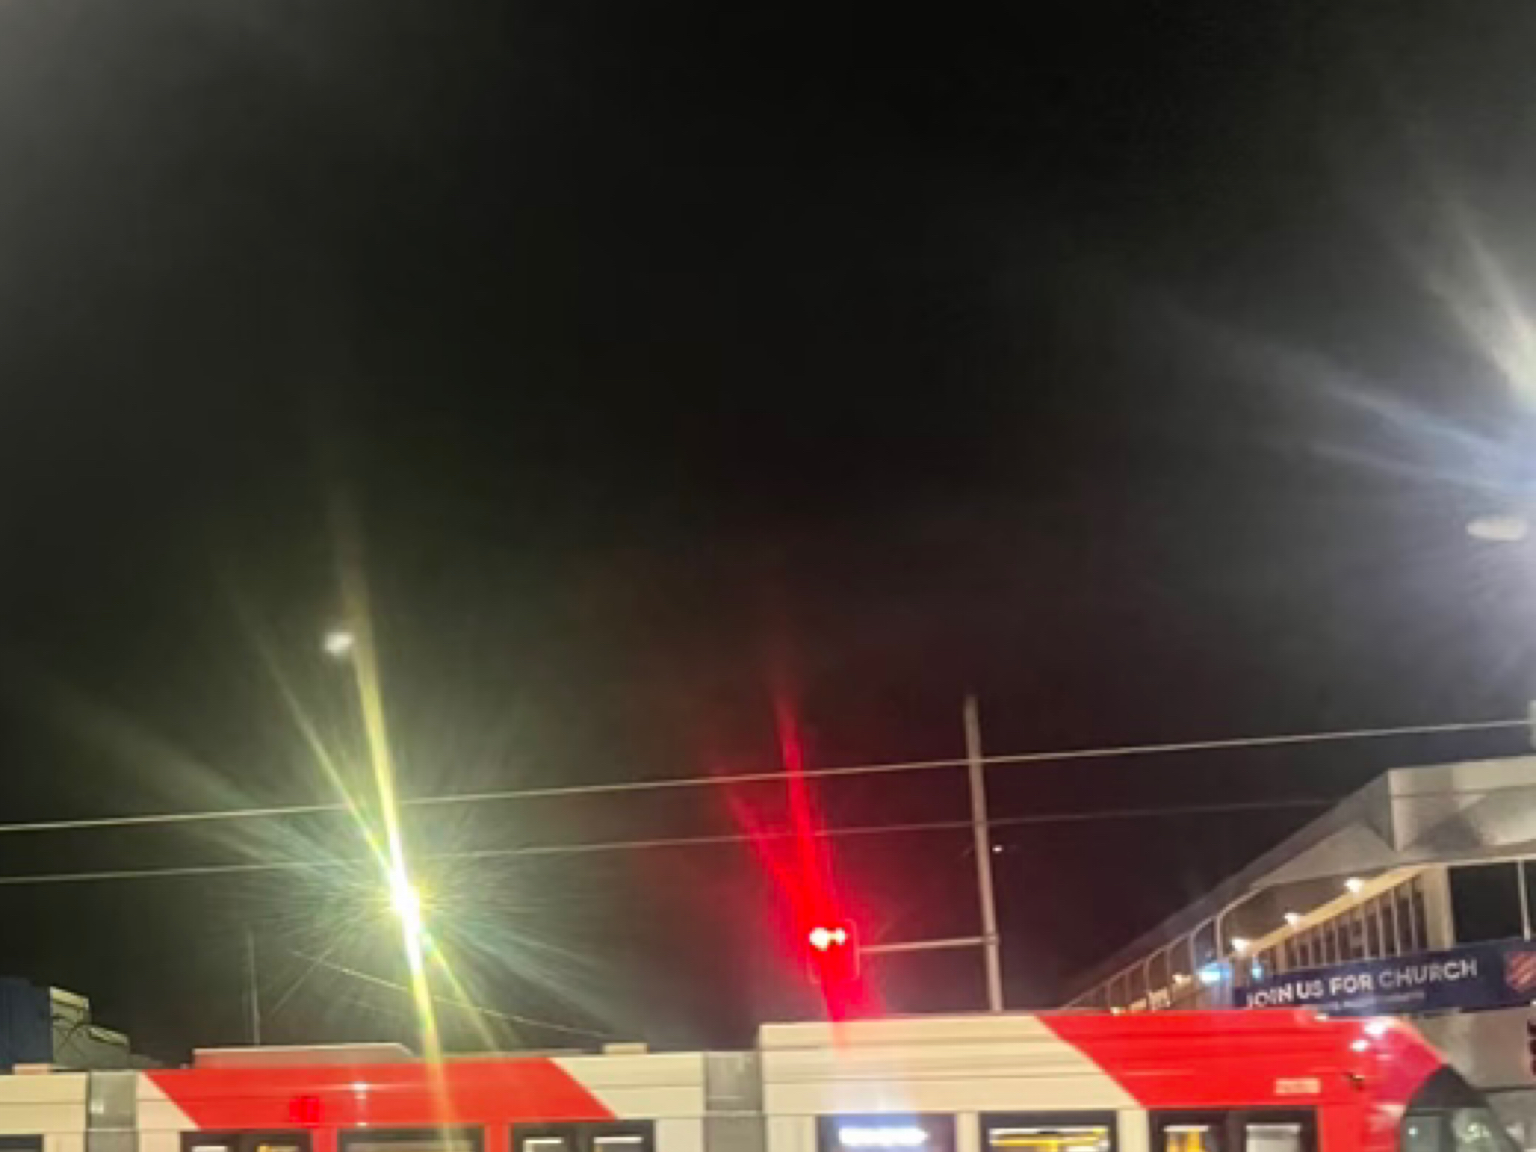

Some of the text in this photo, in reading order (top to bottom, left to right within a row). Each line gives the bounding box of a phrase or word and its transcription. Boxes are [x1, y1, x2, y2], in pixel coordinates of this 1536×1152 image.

[1246, 959, 1478, 1009] JOIN US FOR CHURCH
